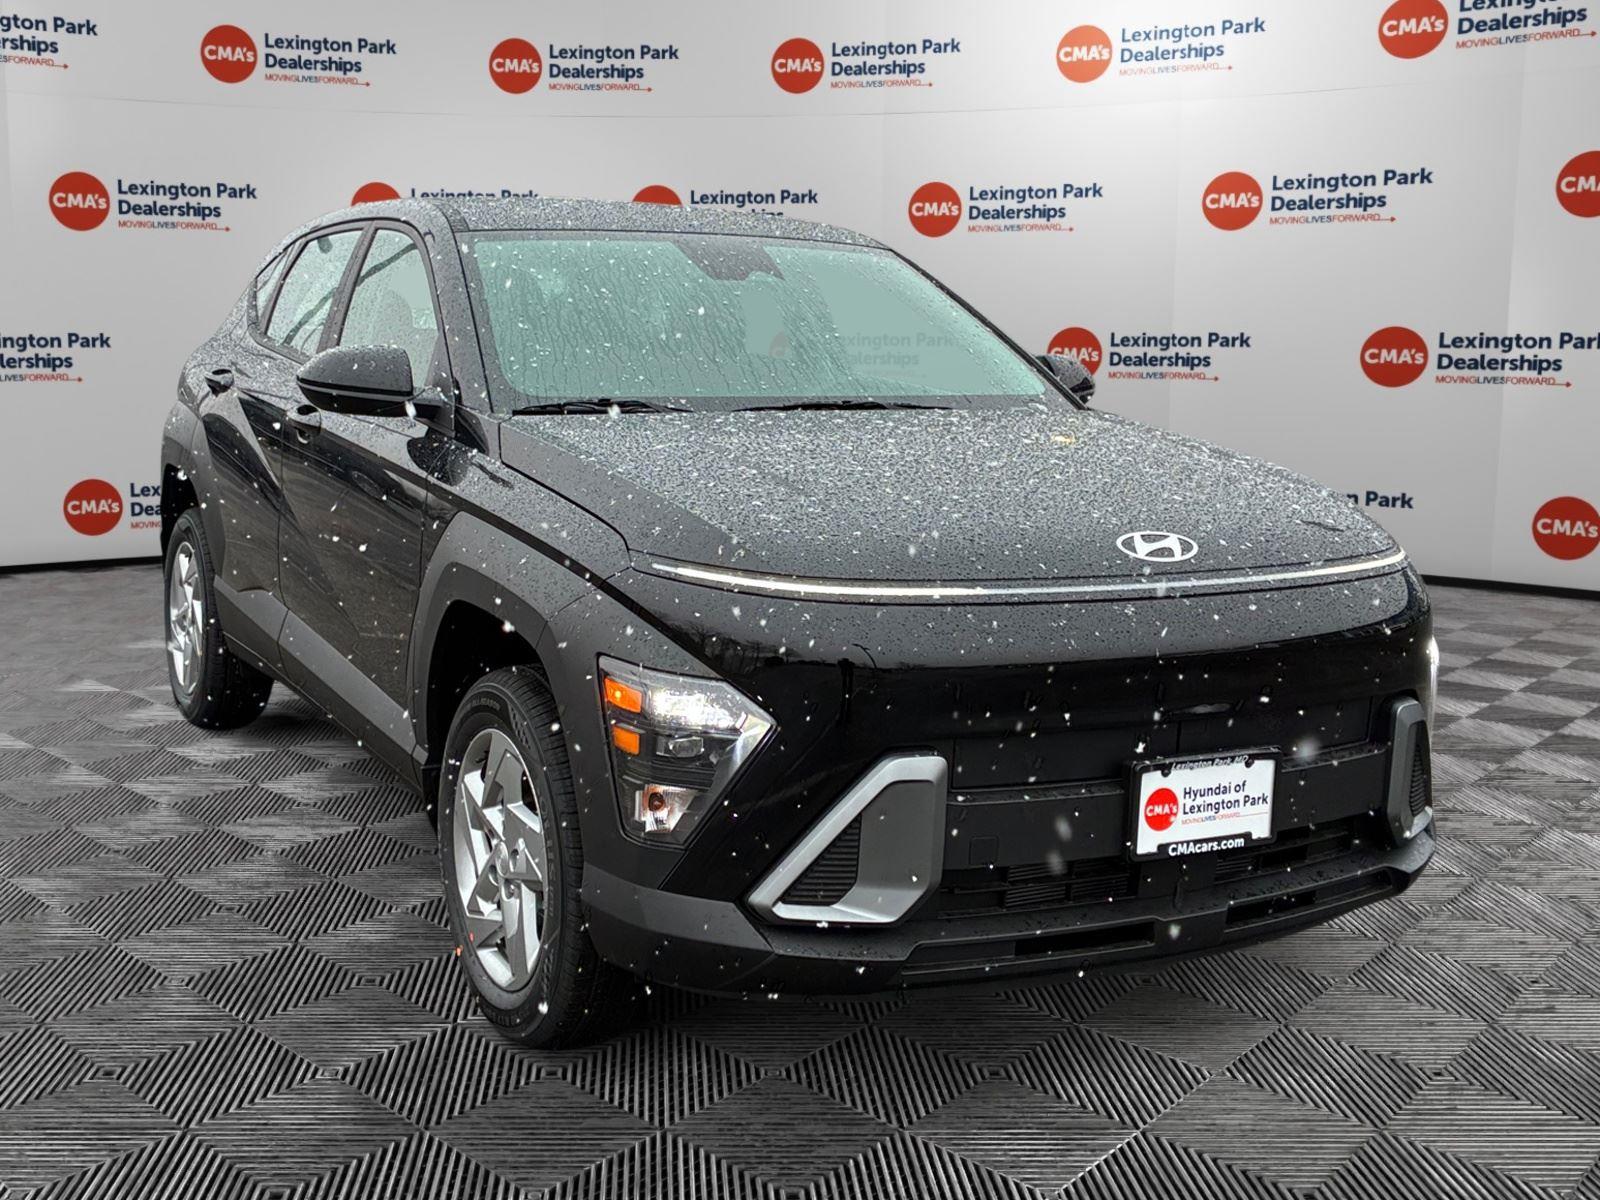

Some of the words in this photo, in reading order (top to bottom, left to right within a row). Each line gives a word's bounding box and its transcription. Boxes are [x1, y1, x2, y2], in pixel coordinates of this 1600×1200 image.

[53, 16, 98, 36] Park
[1121, 24, 1215, 43] Lexington
[1222, 17, 1265, 35] Park
[1382, 15, 1445, 37] CMA's
[1457, 7, 1587, 35] Dealerships
[0, 35, 59, 56] rships
[204, 45, 255, 62] CMA's
[264, 33, 352, 55] Lexington
[358, 38, 397, 54] Park
[549, 44, 635, 63] Lexington
[640, 45, 679, 59] Park
[831, 42, 917, 60] Lexington
[922, 38, 961, 54] Park
[1059, 44, 1110, 62] CMA's
[1120, 42, 1225, 63] Dealerships
[265, 53, 362, 75] Dealerships
[492, 58, 540, 73] CMA's
[549, 64, 644, 82] Dealerships
[774, 58, 822, 73] CMA's
[831, 60, 926, 77] Dealerships
[1272, 173, 1377, 192] Lexington
[1383, 167, 1433, 186] Park
[1560, 176, 1600, 193] CM
[117, 179, 211, 200] Lexington
[217, 183, 257, 199] Park
[691, 190, 775, 208] Lexington
[780, 189, 818, 204] Park
[969, 186, 1057, 204] Lexington
[1063, 183, 1103, 198] Park
[52, 192, 107, 209] CMA's
[118, 200, 221, 220] Dealerships
[911, 201, 959, 217] CMA's
[1205, 192, 1260, 209] CMA's
[1270, 193, 1387, 212] Dealerships
[968, 205, 1066, 222] Dealerships
[67, 332, 111, 348] Park
[1110, 332, 1201, 351] Lexington
[1207, 332, 1251, 348] Park
[1439, 332, 1551, 354] Lexington
[0, 353, 73, 372] lerships
[1109, 352, 1211, 370] Dealerships
[1364, 348, 1425, 365] CMA's
[1437, 354, 1563, 375] Dealerships
[67, 499, 120, 515] CMA's
[1365, 491, 1414, 509] Park
[1536, 518, 1599, 538] CMA's
[1183, 782, 1232, 802] Hyundai
[1234, 780, 1247, 793] of
[1146, 803, 1178, 817] CMA's
[1183, 799, 1240, 815] Lexington
[1243, 793, 1269, 808] Park
[1168, 837, 1245, 857] CMAcars.com
